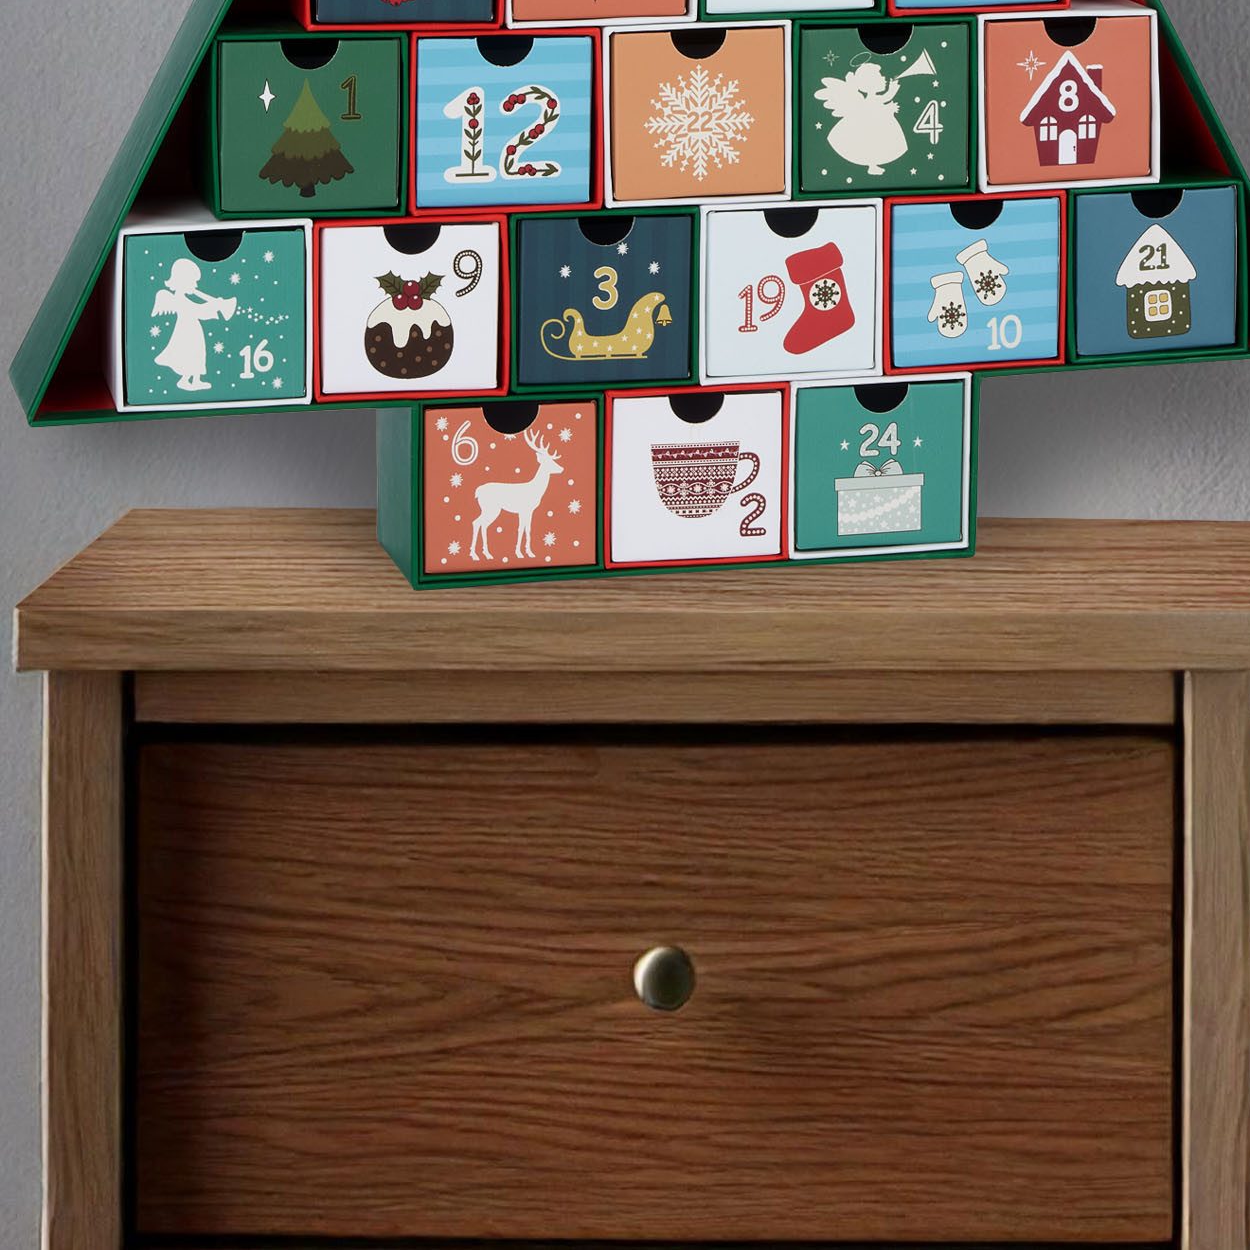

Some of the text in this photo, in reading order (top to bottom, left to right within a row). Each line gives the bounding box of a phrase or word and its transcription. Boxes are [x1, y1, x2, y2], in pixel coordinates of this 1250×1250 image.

[340, 75, 361, 120] 1
[1058, 80, 1080, 113] 8
[442, 85, 562, 184] 12
[687, 110, 714, 133] 22
[913, 99, 944, 145] 4
[453, 249, 483, 298] 9
[1138, 242, 1170, 271] 21
[592, 266, 618, 311] 3
[737, 274, 785, 333] 19
[985, 313, 1023, 351] 10
[239, 338, 275, 380] 16
[451, 419, 479, 466] 6
[858, 421, 901, 457] 24
[739, 492, 767, 537] 2
